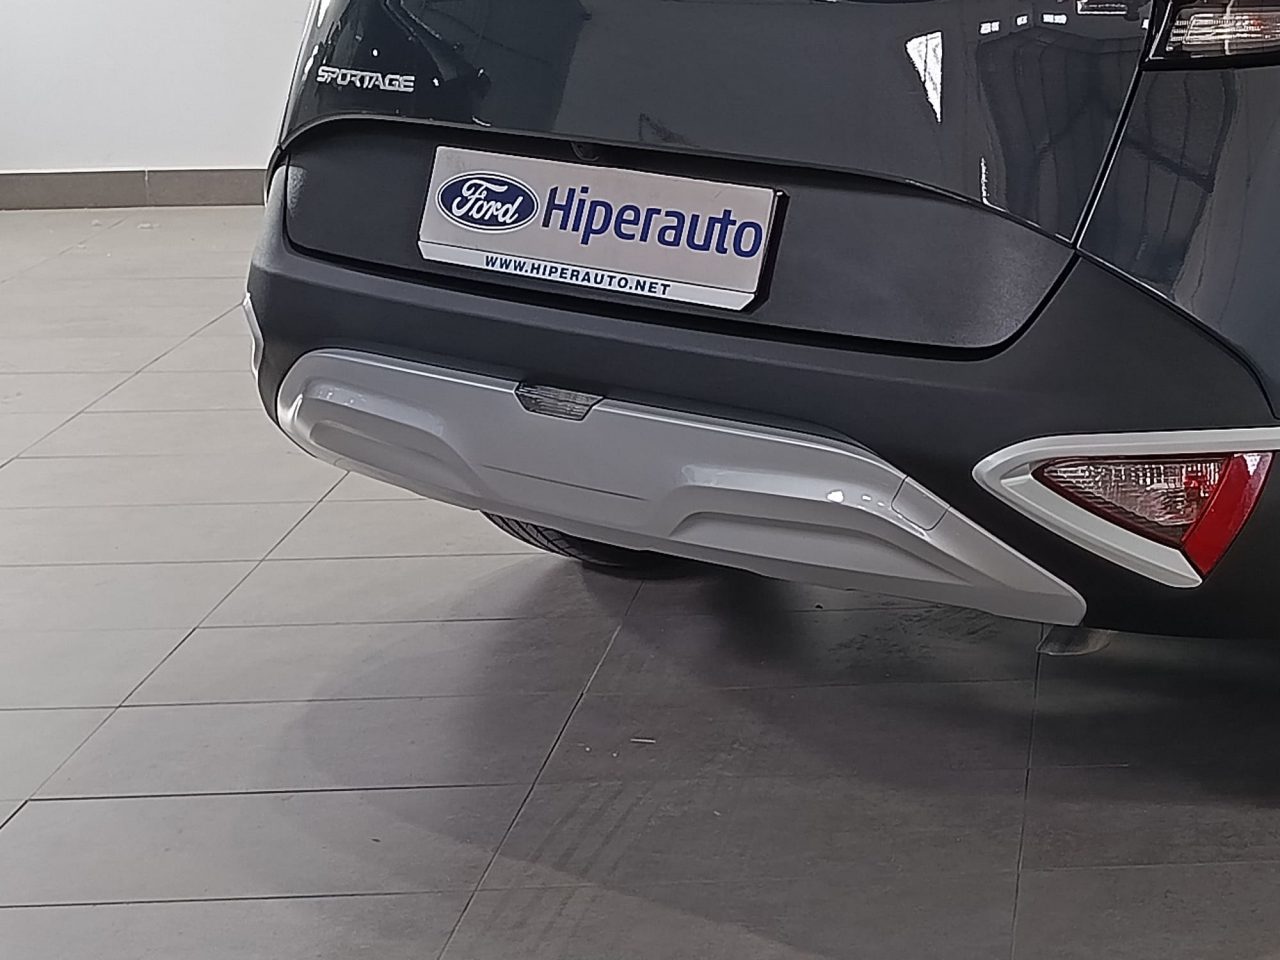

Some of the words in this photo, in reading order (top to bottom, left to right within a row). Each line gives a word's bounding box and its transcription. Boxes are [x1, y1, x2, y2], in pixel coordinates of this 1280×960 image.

[316, 65, 415, 93] SPORTAGE
[451, 179, 520, 225] Ford
[541, 185, 763, 259] Hiperauto
[484, 254, 672, 296] WWW.HIPERAUTO.NET
